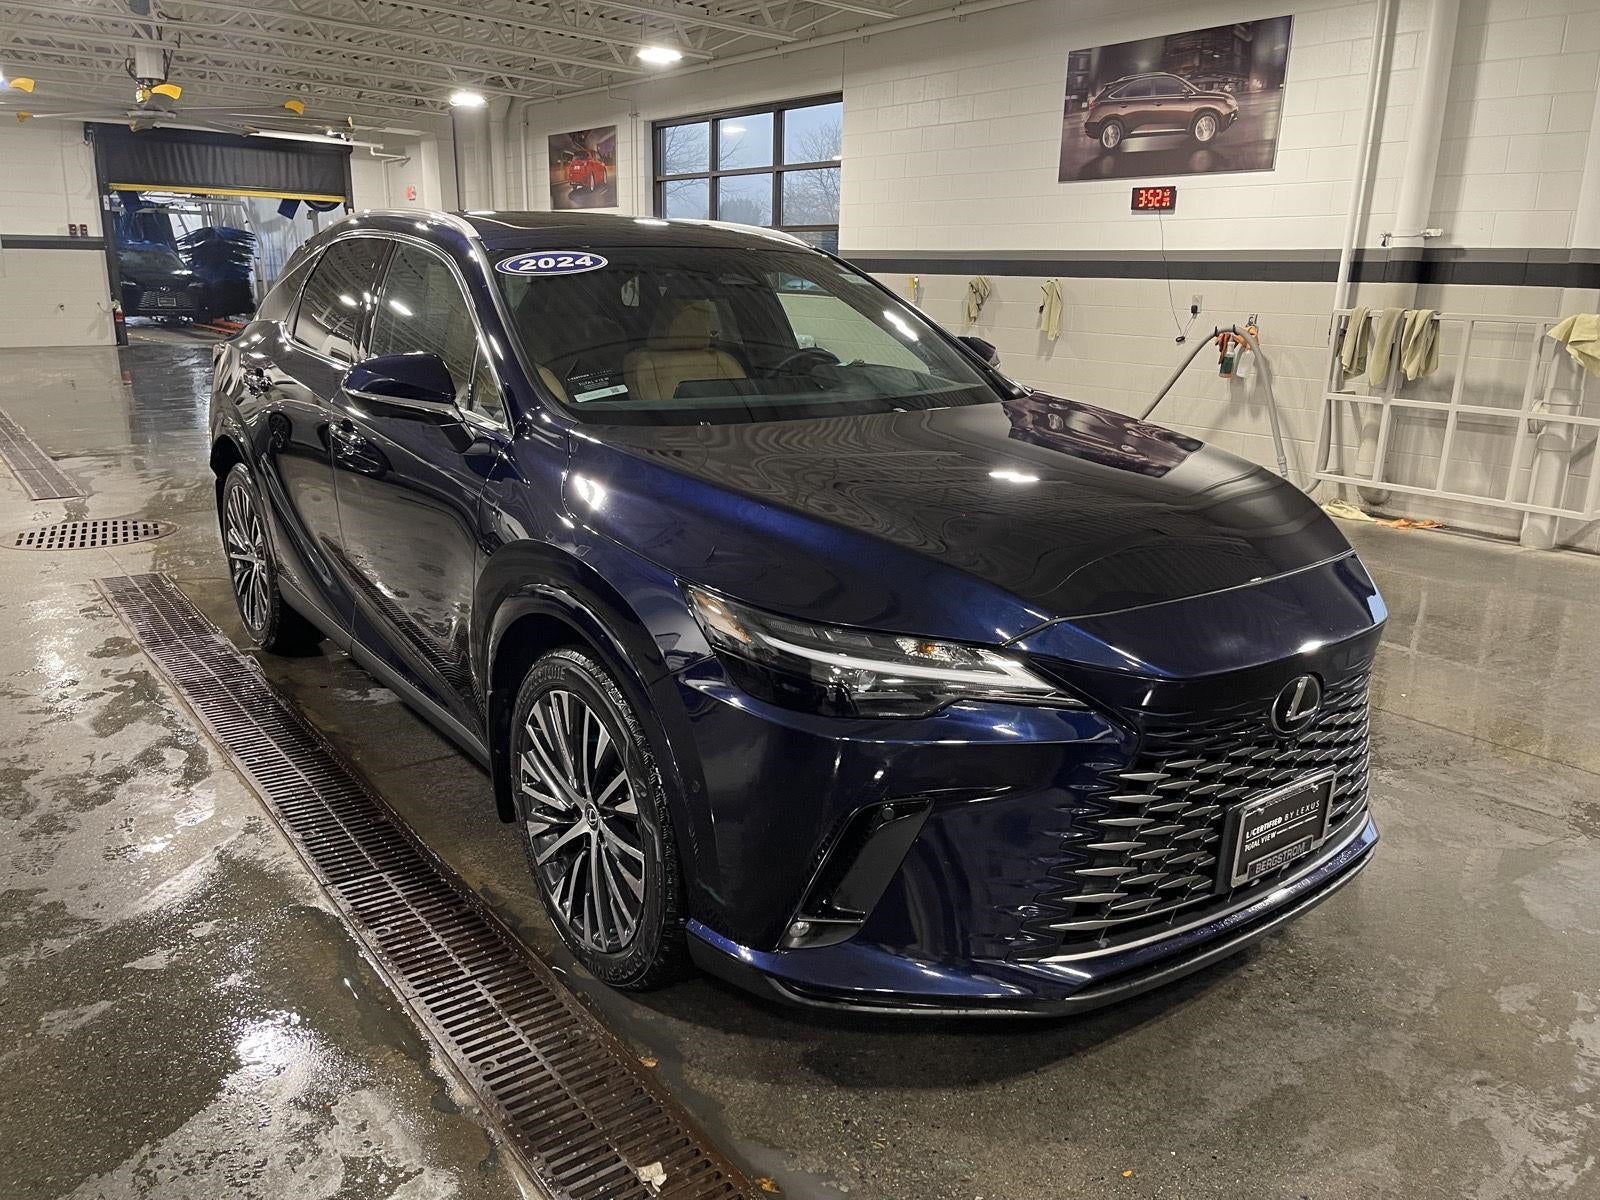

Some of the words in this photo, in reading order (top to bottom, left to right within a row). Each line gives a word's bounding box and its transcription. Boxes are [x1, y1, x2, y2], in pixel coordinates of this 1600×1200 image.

[1138, 189, 1162, 207] 3:52
[518, 255, 594, 271] 2024
[1284, 811, 1295, 821] BY
[1296, 799, 1321, 816] LEXUS
[1244, 839, 1261, 853] TOTAL
[1261, 830, 1278, 844] VIEW
[1255, 842, 1307, 875] BERGSTROM
